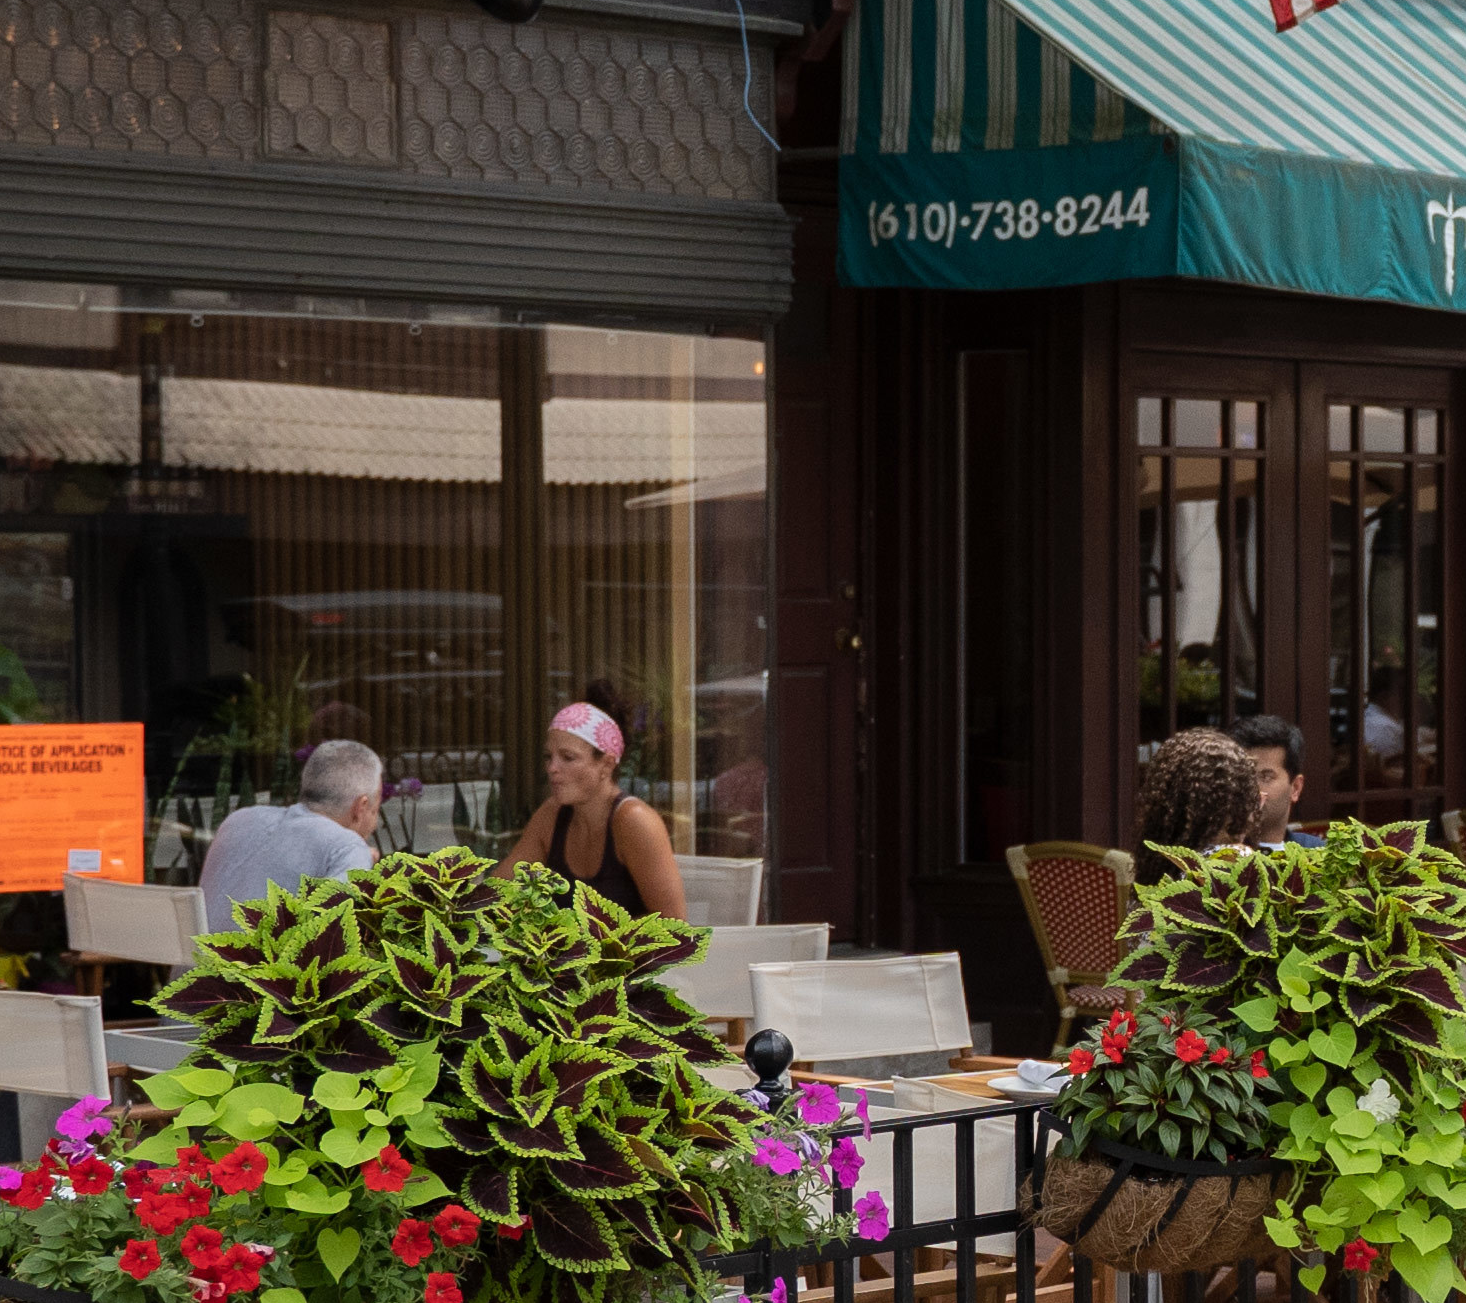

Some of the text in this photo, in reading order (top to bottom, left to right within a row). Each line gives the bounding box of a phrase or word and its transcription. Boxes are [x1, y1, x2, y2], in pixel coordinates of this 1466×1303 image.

[30, 745, 45, 758] OF
[51, 743, 126, 757] APPLICATION
[32, 759, 103, 774] BEVERAGES
